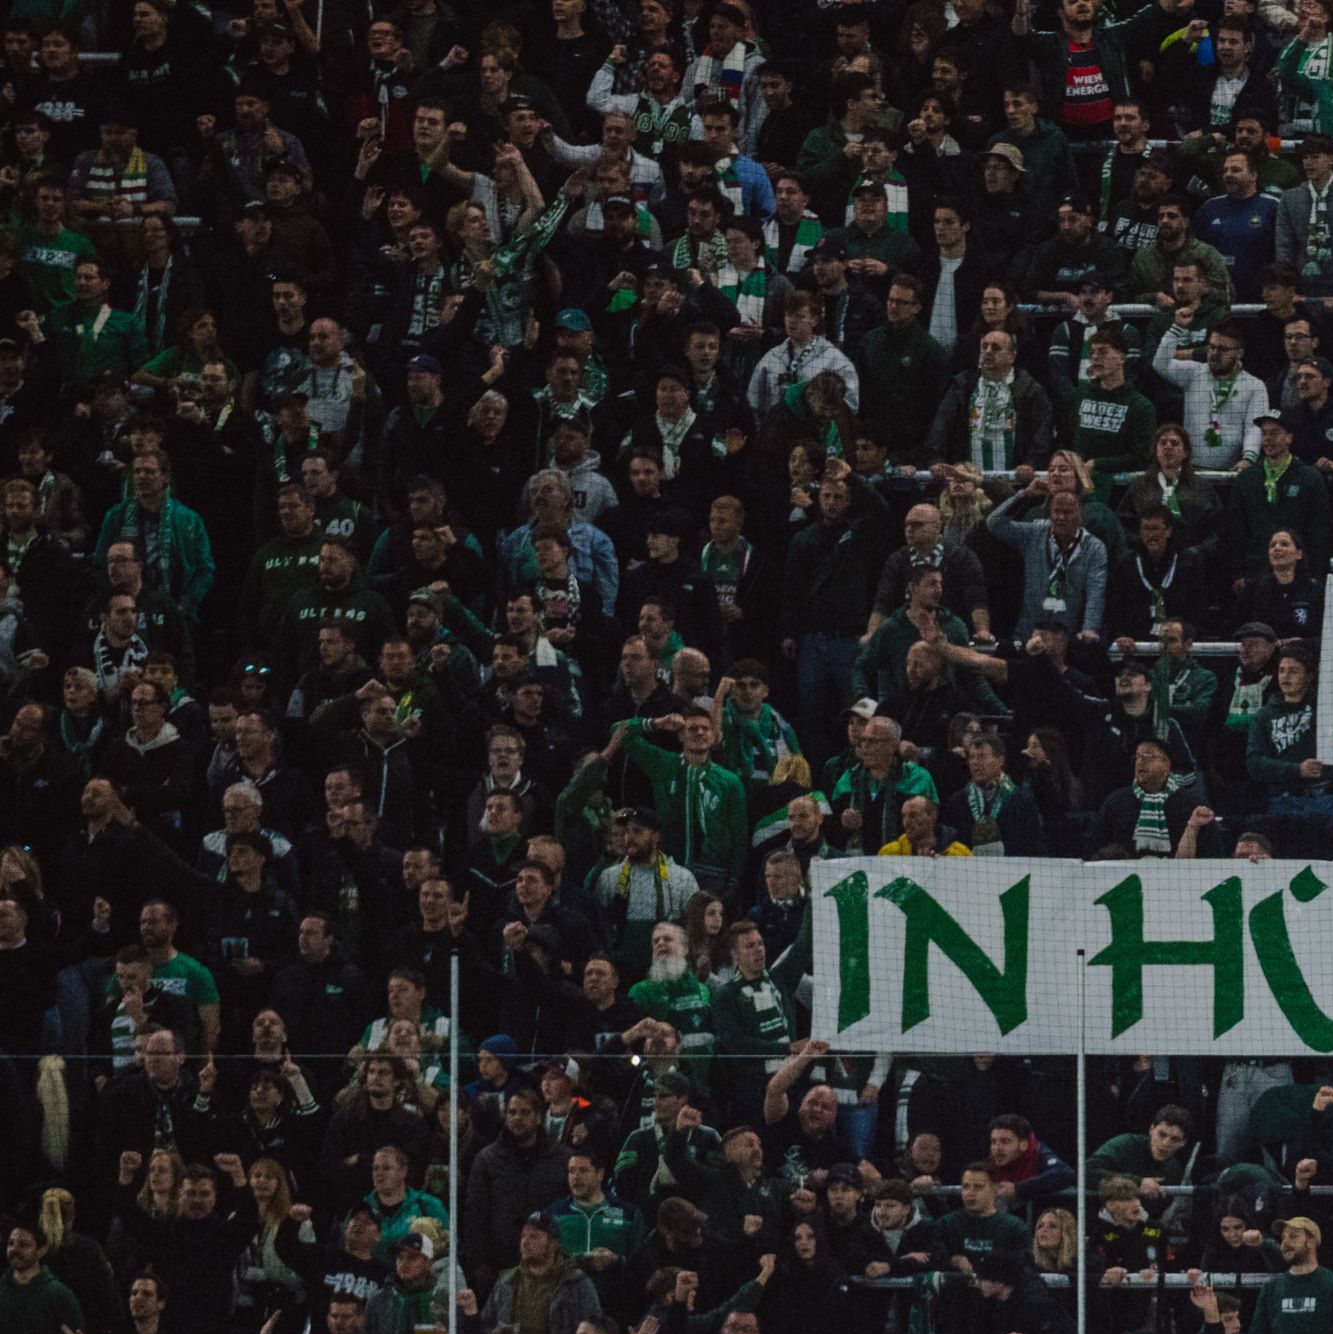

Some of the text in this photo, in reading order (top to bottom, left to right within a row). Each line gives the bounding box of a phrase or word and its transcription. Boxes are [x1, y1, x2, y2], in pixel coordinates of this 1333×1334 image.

[1072, 75, 1103, 85] WIEN
[1080, 400, 1129, 418] BLOCK
[1079, 414, 1125, 433] WEST
[828, 871, 1030, 1034] IN
